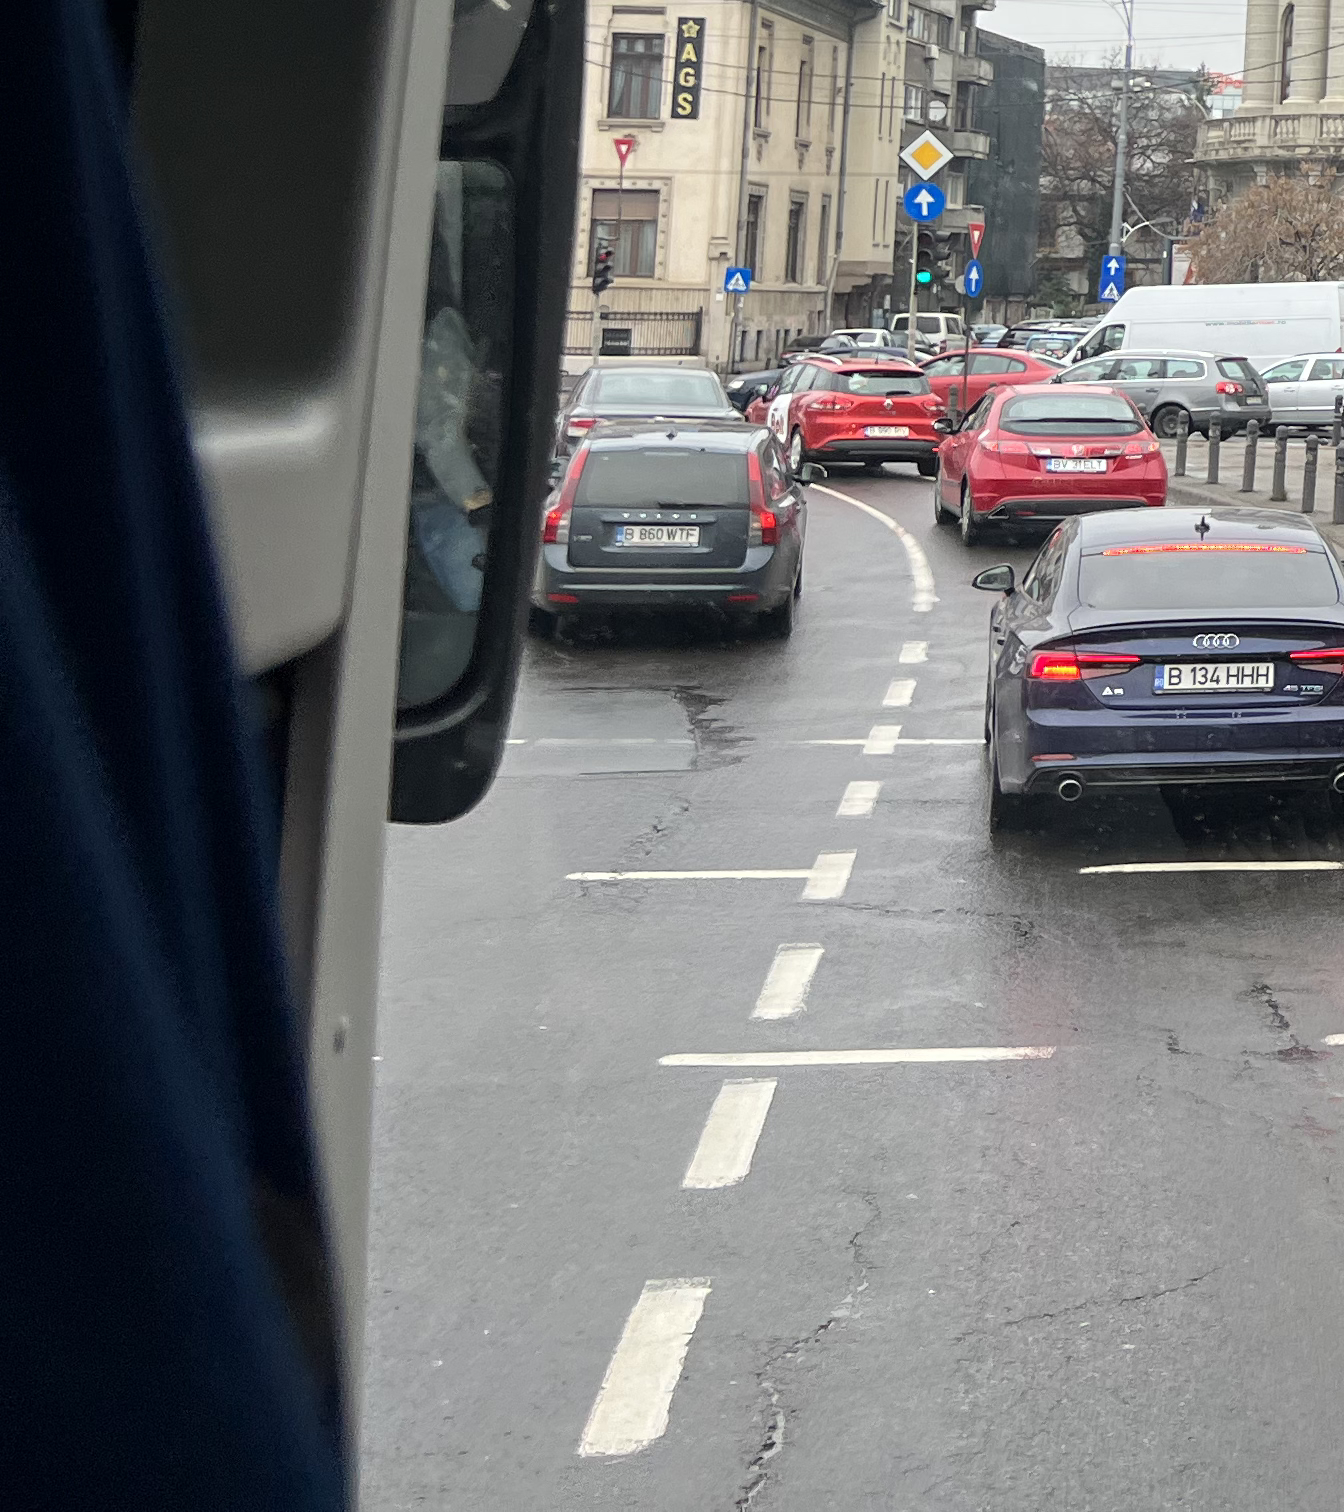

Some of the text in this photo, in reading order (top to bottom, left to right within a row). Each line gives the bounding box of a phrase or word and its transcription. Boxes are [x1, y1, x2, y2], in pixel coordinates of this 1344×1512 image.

[676, 42, 698, 116] AGS
[1053, 459, 1068, 470] BV
[624, 527, 635, 541] B
[639, 527, 664, 541] 860
[1168, 665, 1270, 686] B 134 HHH
